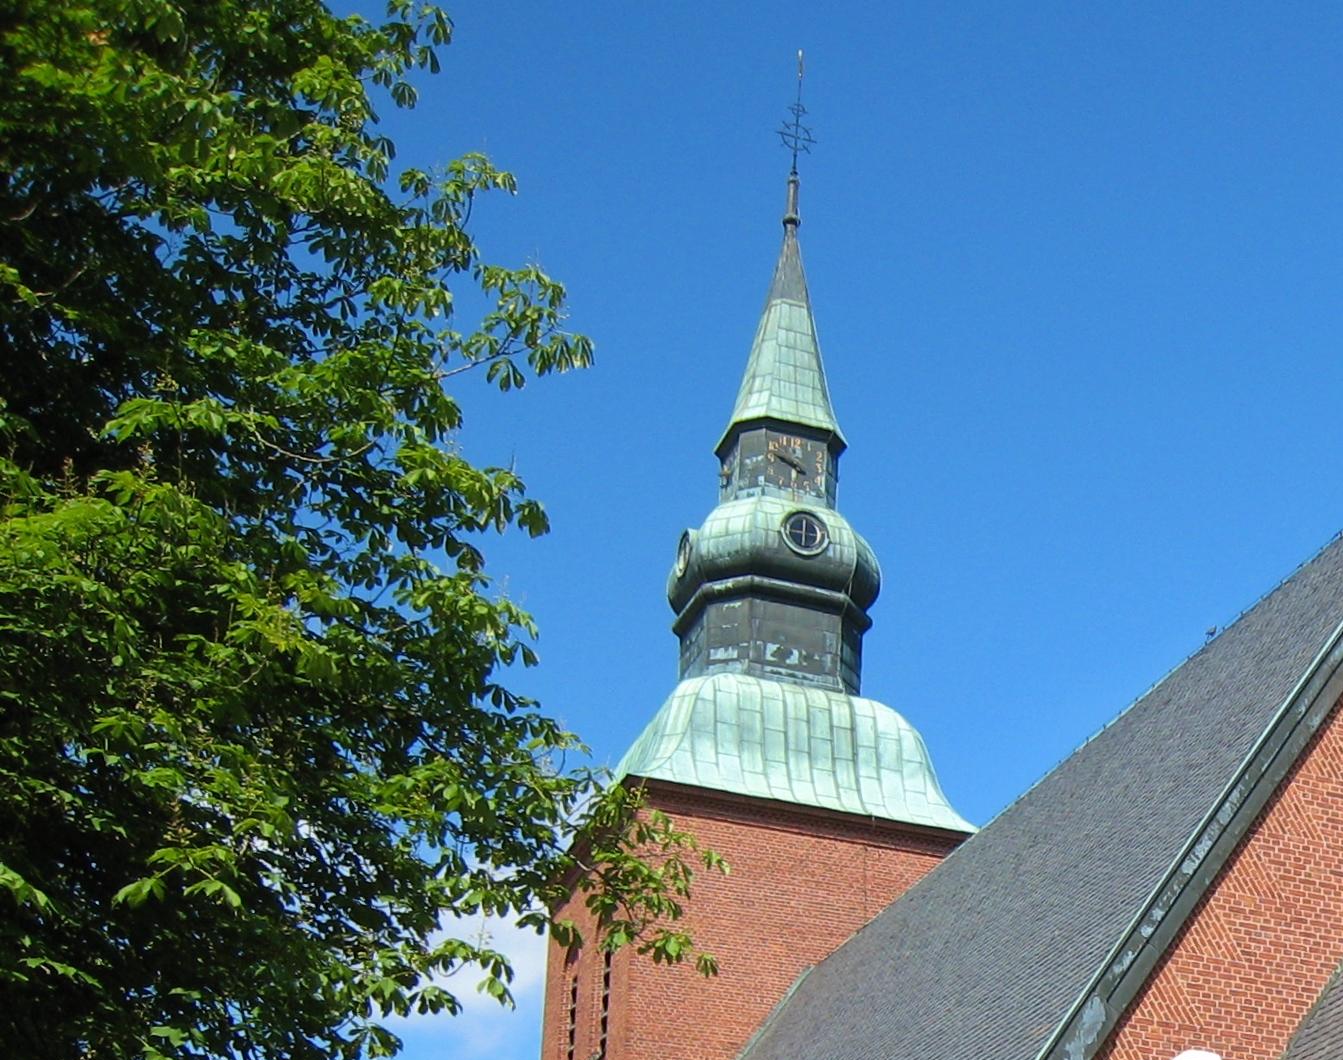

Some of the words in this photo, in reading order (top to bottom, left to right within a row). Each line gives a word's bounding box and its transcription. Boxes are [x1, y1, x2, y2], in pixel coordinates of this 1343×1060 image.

[790, 437, 801, 448] 12
[767, 452, 775, 463] 9
[815, 451, 823, 462] 2
